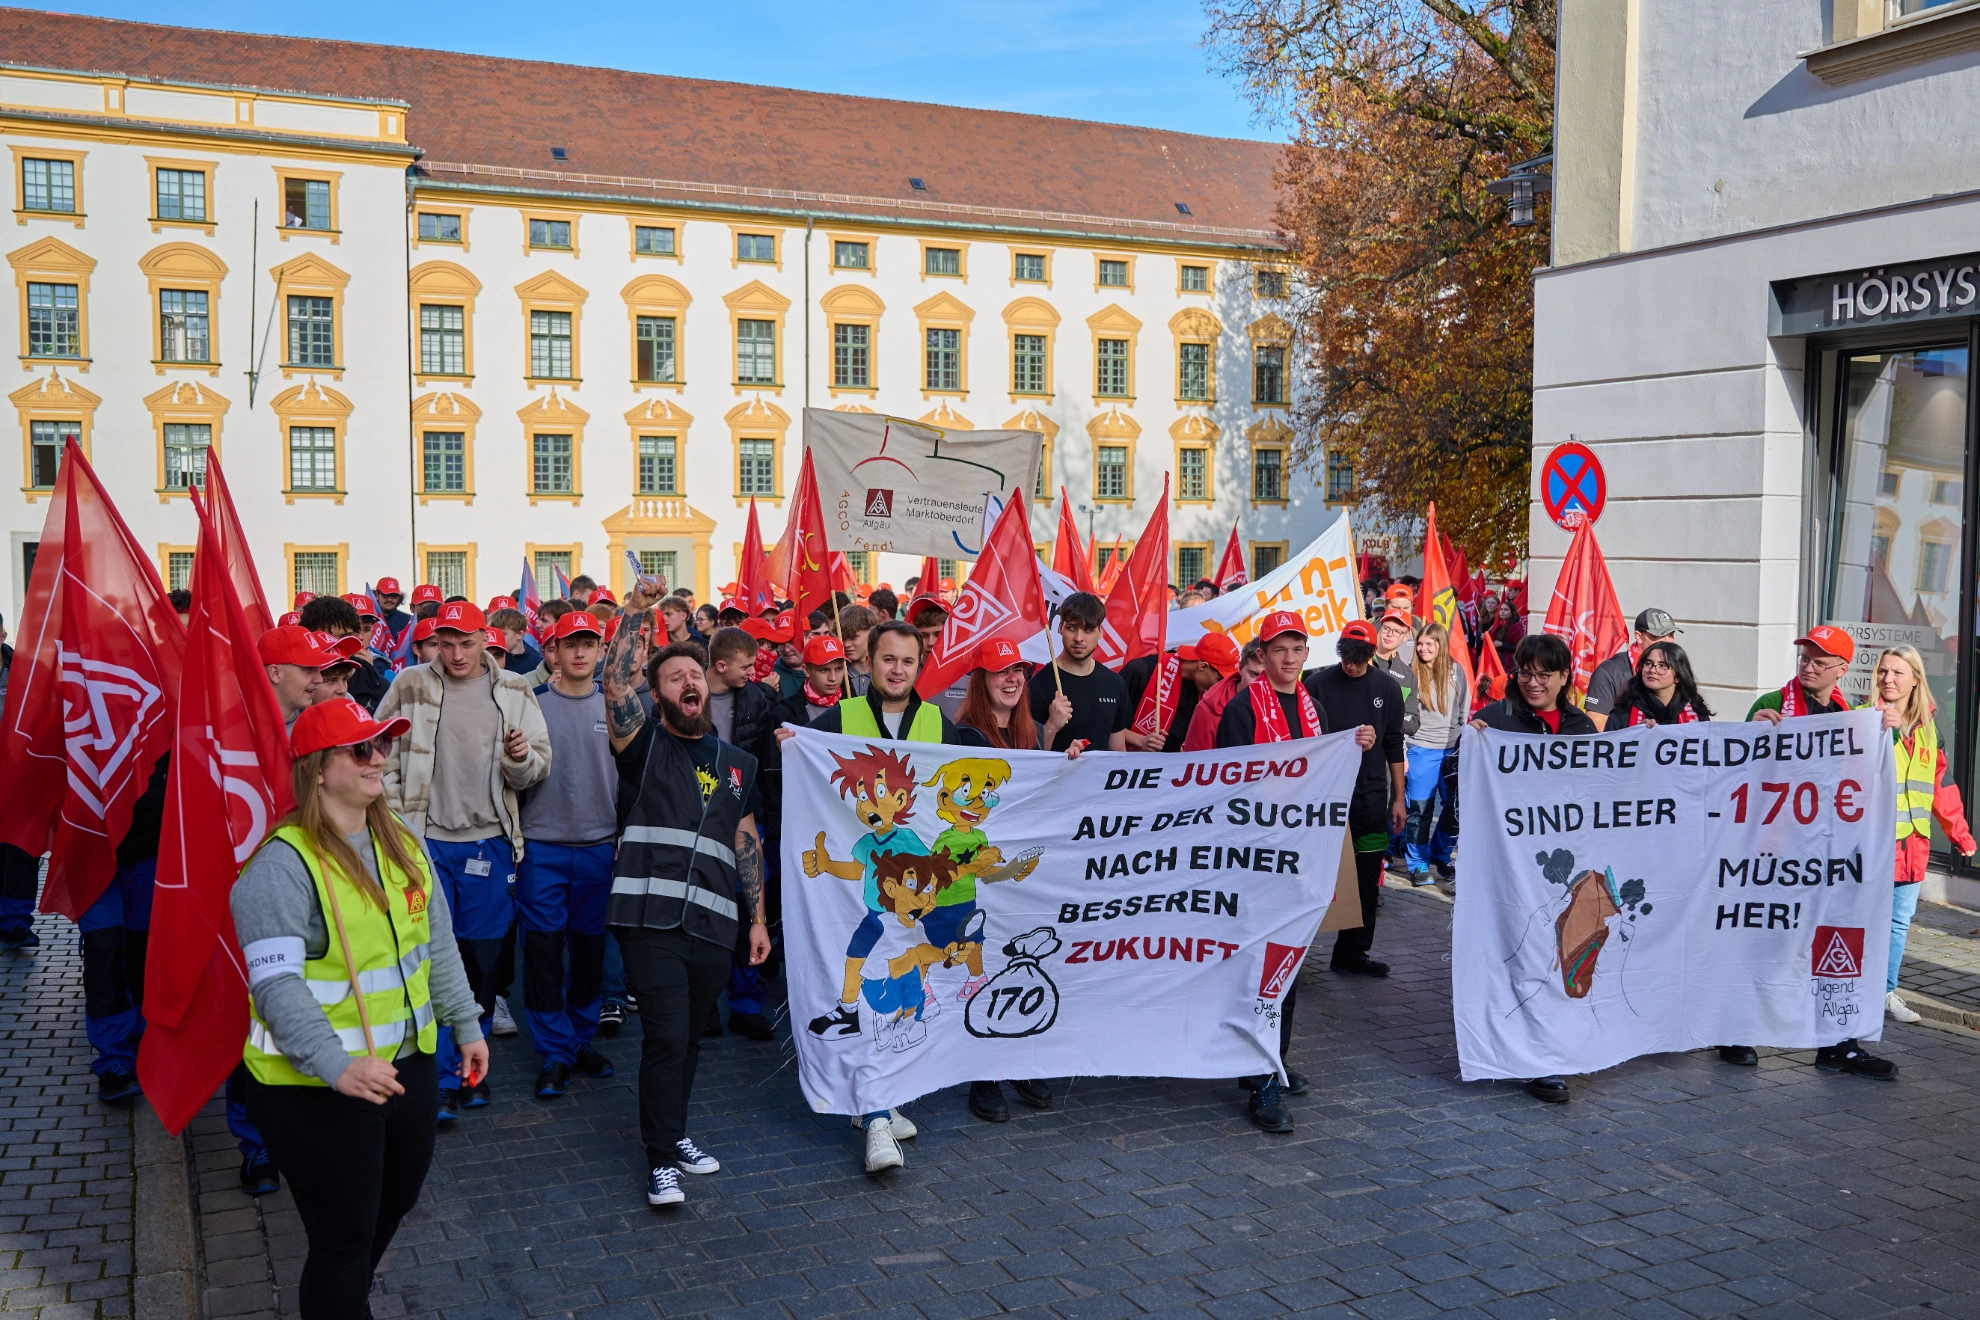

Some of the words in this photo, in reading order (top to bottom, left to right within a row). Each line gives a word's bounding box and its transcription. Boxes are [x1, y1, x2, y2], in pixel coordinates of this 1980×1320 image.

[1832, 265, 1980, 320] HÖRSYS
[837, 490, 851, 531] AGCO
[854, 537, 895, 551] Fendt
[905, 507, 975, 525] Marktoberdorf
[907, 495, 984, 514] Vertrauensleute
[863, 519, 891, 531] Allgäu
[1498, 740, 1639, 773] UNSERE
[1655, 727, 1864, 767] GELDBEUTEL
[1104, 768, 1163, 790] DIE
[1171, 757, 1308, 787] JUGEND
[1071, 814, 1142, 841] AUF
[1151, 805, 1215, 832] DER
[1226, 798, 1347, 828] SUCHE
[1505, 803, 1584, 836] SIND
[1593, 797, 1676, 829] LEER
[1085, 846, 1177, 880] NACH
[1190, 845, 1300, 874] EINER
[1058, 889, 1239, 924] BESSEREN
[1715, 902, 1801, 930] HER!
[1065, 937, 1240, 964] ZUKUNFT
[987, 986, 1044, 1020] 170
[1811, 978, 1854, 1001] Jugend
[1822, 999, 1859, 1025] Allgäu
